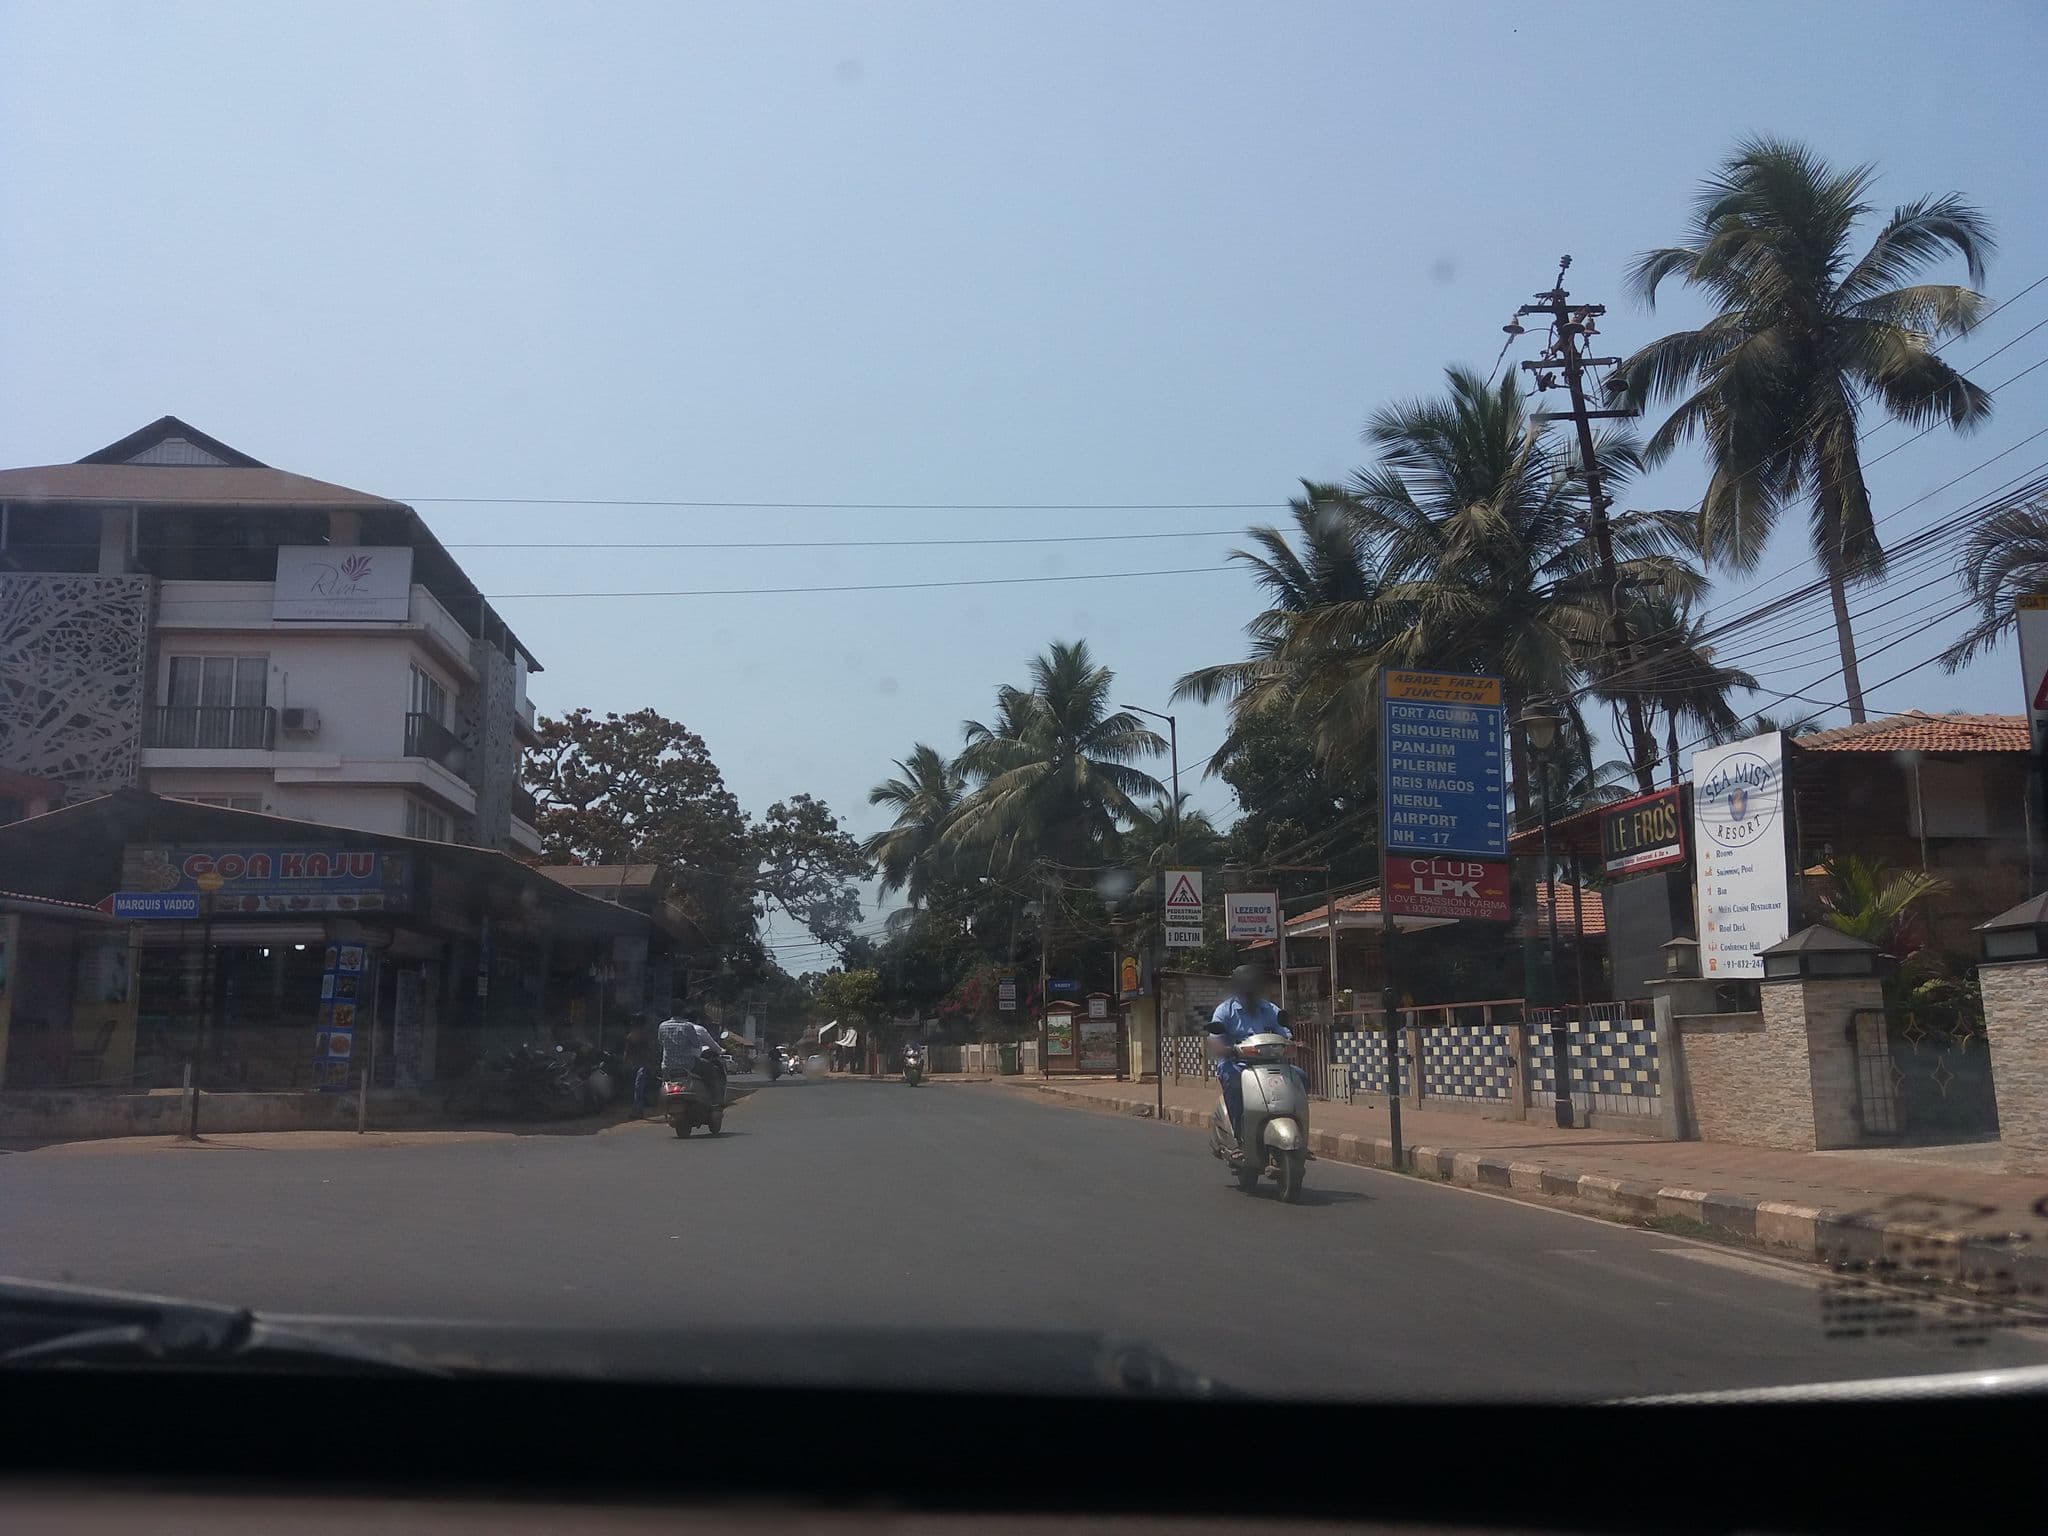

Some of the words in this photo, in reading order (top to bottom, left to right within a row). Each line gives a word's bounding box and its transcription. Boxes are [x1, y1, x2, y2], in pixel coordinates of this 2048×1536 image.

[1394, 674, 1440, 686] ABADE
[1448, 678, 1494, 689] FARIA
[1399, 687, 1484, 701] JUNCTION
[1391, 706, 1424, 718] FORT
[1427, 709, 1479, 722] AGUADA
[1391, 723, 1479, 740] SINQUERIM
[1391, 740, 1456, 756] PANJIM
[1391, 758, 1456, 773] PILERNE
[1392, 776, 1423, 788] REIS
[1427, 778, 1475, 792] MAGOS
[1705, 768, 1731, 803] SEA
[1735, 762, 1770, 792] MIST
[1392, 794, 1442, 808] NERUL
[1392, 811, 1457, 826] AIRPORT
[1717, 814, 1761, 839] RESORT
[1393, 829, 1414, 842] NH
[1431, 832, 1450, 844] 17
[183, 853, 272, 880] GOA
[280, 852, 375, 880] KAJU
[1410, 859, 1485, 878] CLUB
[1414, 877, 1481, 898] LPK
[117, 899, 161, 911] MARQUIS
[163, 899, 195, 910] VADDO
[1235, 906, 1272, 914] LEZERO'S
[1388, 894, 1417, 903] LOVE
[1419, 896, 1467, 907] PASSION
[1469, 899, 1507, 910] KARMA
[1174, 932, 1200, 942] DELTIN
